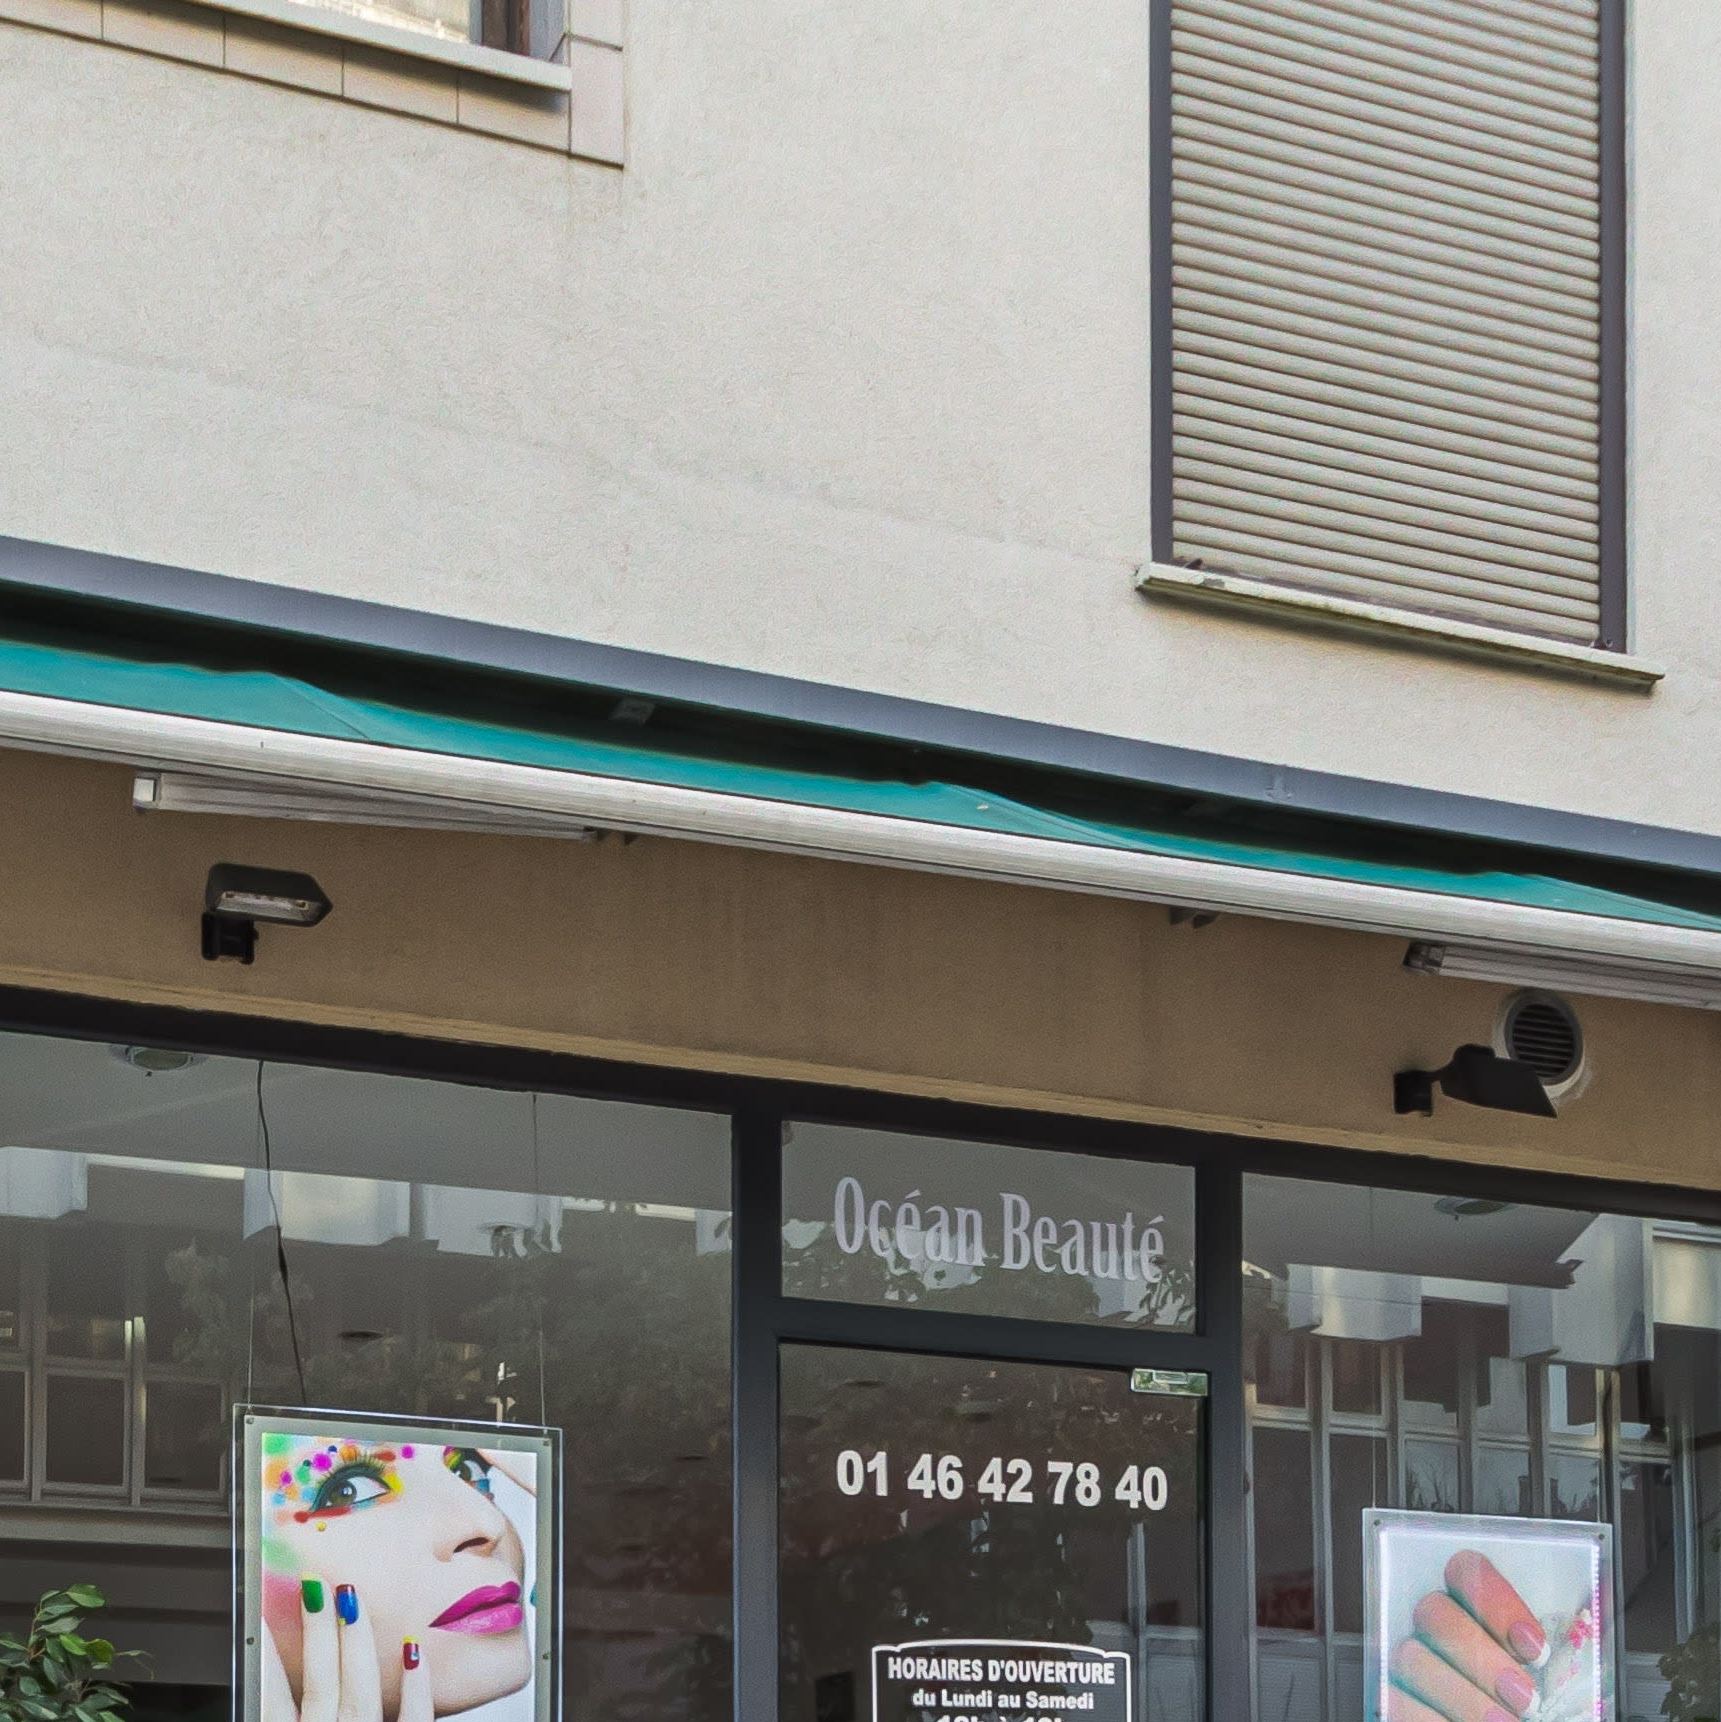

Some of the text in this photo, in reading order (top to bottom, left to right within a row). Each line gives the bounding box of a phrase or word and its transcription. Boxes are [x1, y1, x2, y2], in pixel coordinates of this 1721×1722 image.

[834, 1176, 1166, 1284] Océan Beauté
[836, 1450, 1168, 1511] 01 46 42 78 40
[888, 1656, 1116, 1685] HORAIRES D'OUVERTURE
[912, 1688, 1095, 1710] du Lundi au Samedi
